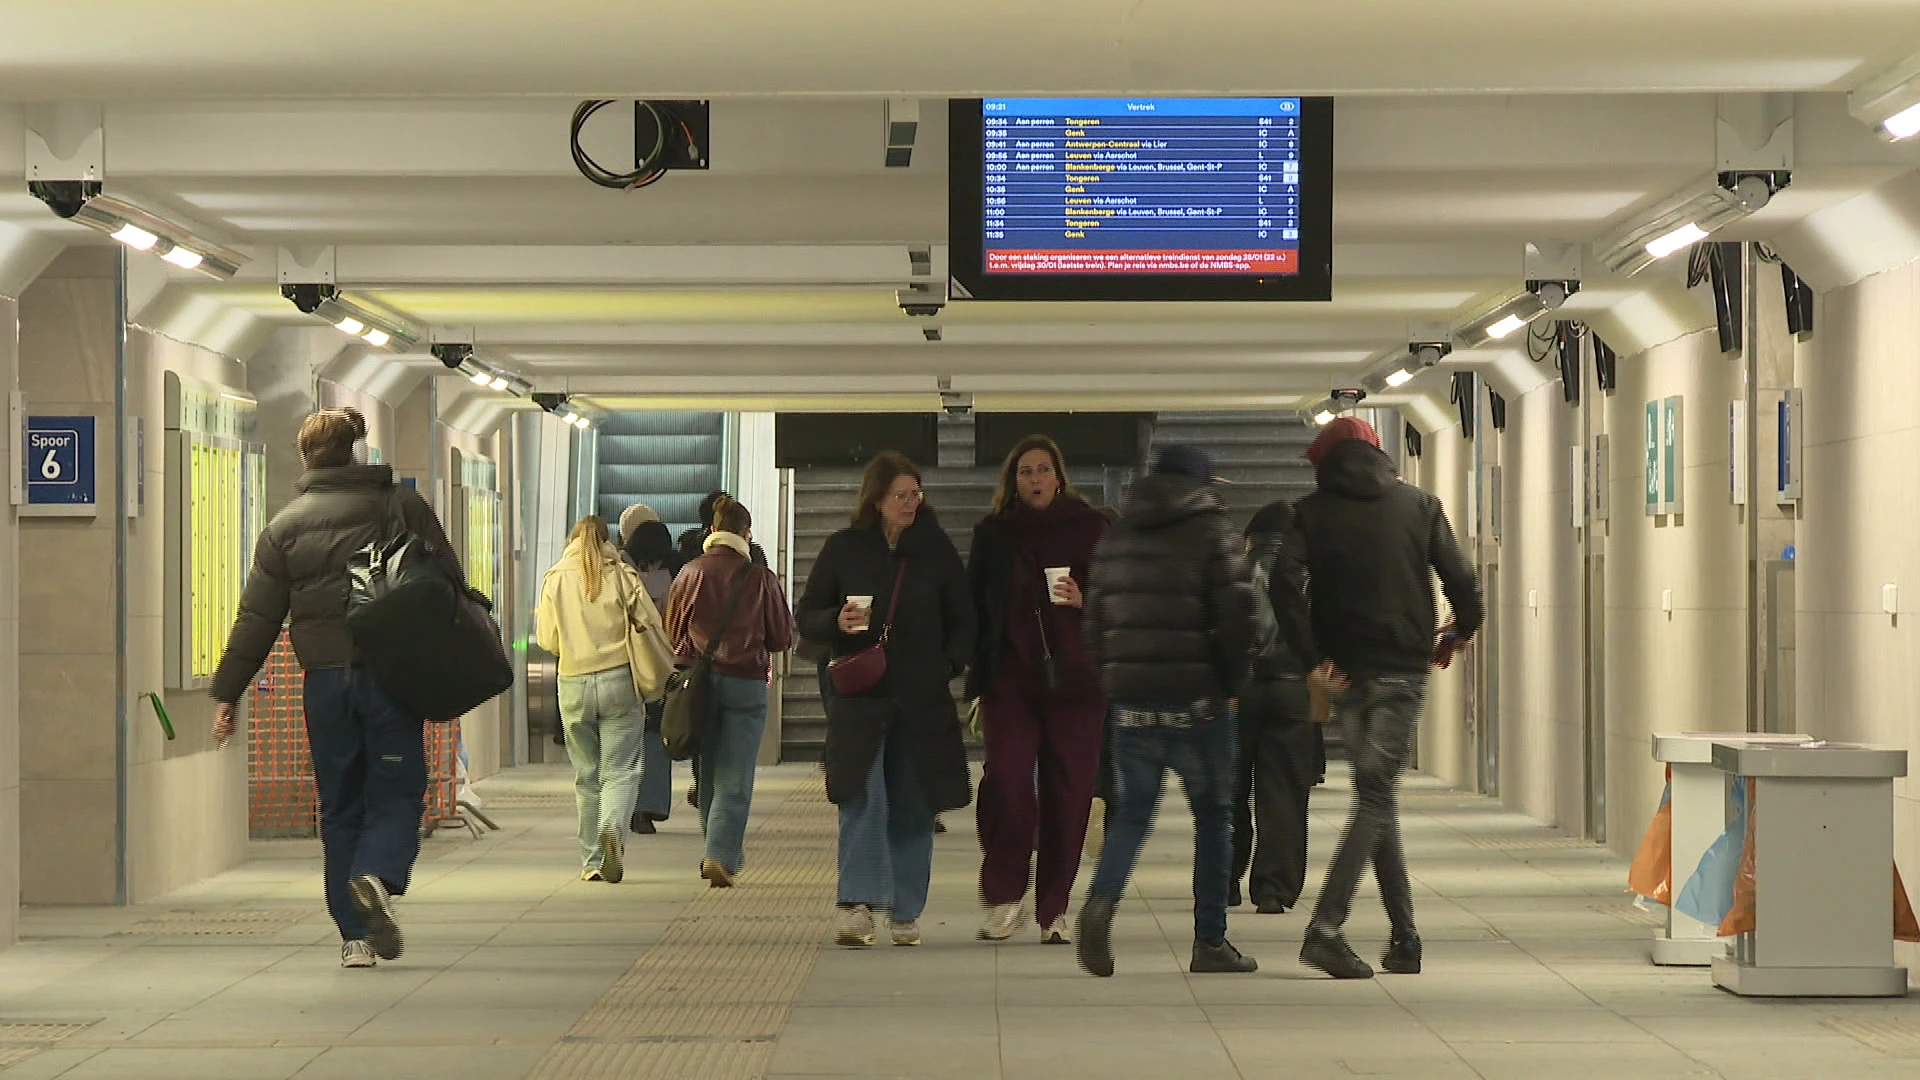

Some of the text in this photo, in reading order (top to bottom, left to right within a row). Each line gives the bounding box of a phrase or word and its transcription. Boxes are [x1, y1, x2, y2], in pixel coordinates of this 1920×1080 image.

[1031, 118, 1055, 127] perron
[1065, 118, 1100, 127] Tongeren
[1031, 141, 1055, 149] perron
[1065, 141, 1140, 149] Antwerpen-Centraal
[1031, 152, 1055, 161] perron
[1031, 163, 1055, 172] perron
[1065, 163, 1116, 172] Blankenberge
[1065, 175, 1100, 184] Tongeren
[1065, 208, 1116, 217] Blankenberge
[1065, 220, 1100, 228] Tongeren
[1024, 253, 1049, 262] staking
[1050, 253, 1091, 262] organiseren
[1216, 253, 1241, 262] zondag
[1011, 262, 1035, 270] vrijdag
[32, 434, 70, 449] Spoor
[42, 450, 61, 479] 6
